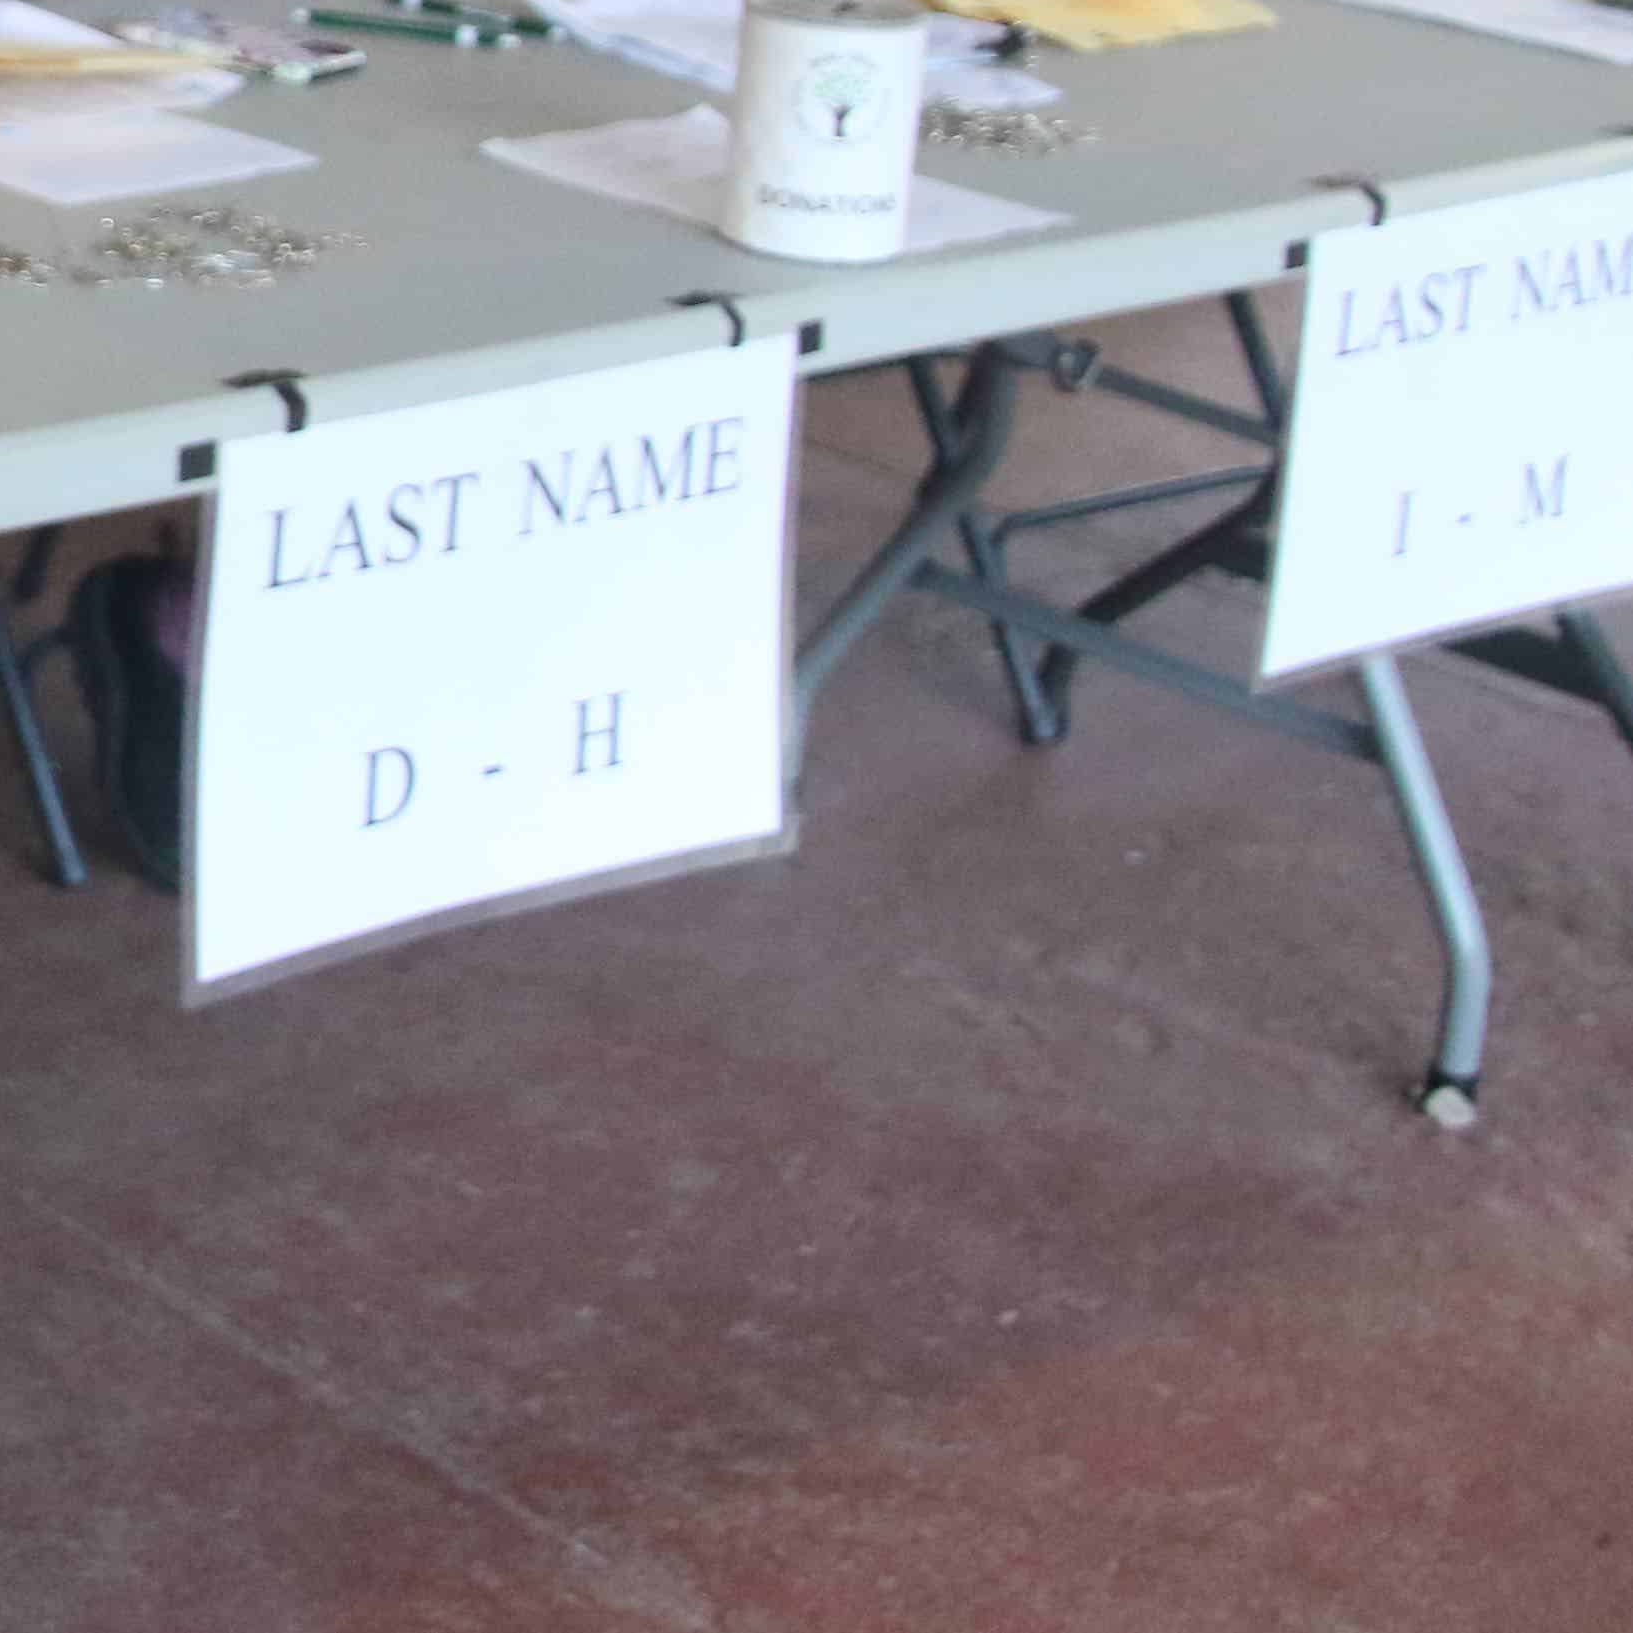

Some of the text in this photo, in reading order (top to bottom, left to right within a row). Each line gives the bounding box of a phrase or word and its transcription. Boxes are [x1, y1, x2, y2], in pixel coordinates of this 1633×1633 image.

[1334, 232, 1632, 356] LAST NAM
[262, 415, 744, 590] LAST NAME
[1391, 489, 1418, 556] I
[1519, 447, 1572, 525] M
[362, 746, 416, 827] D
[571, 690, 626, 775] H
